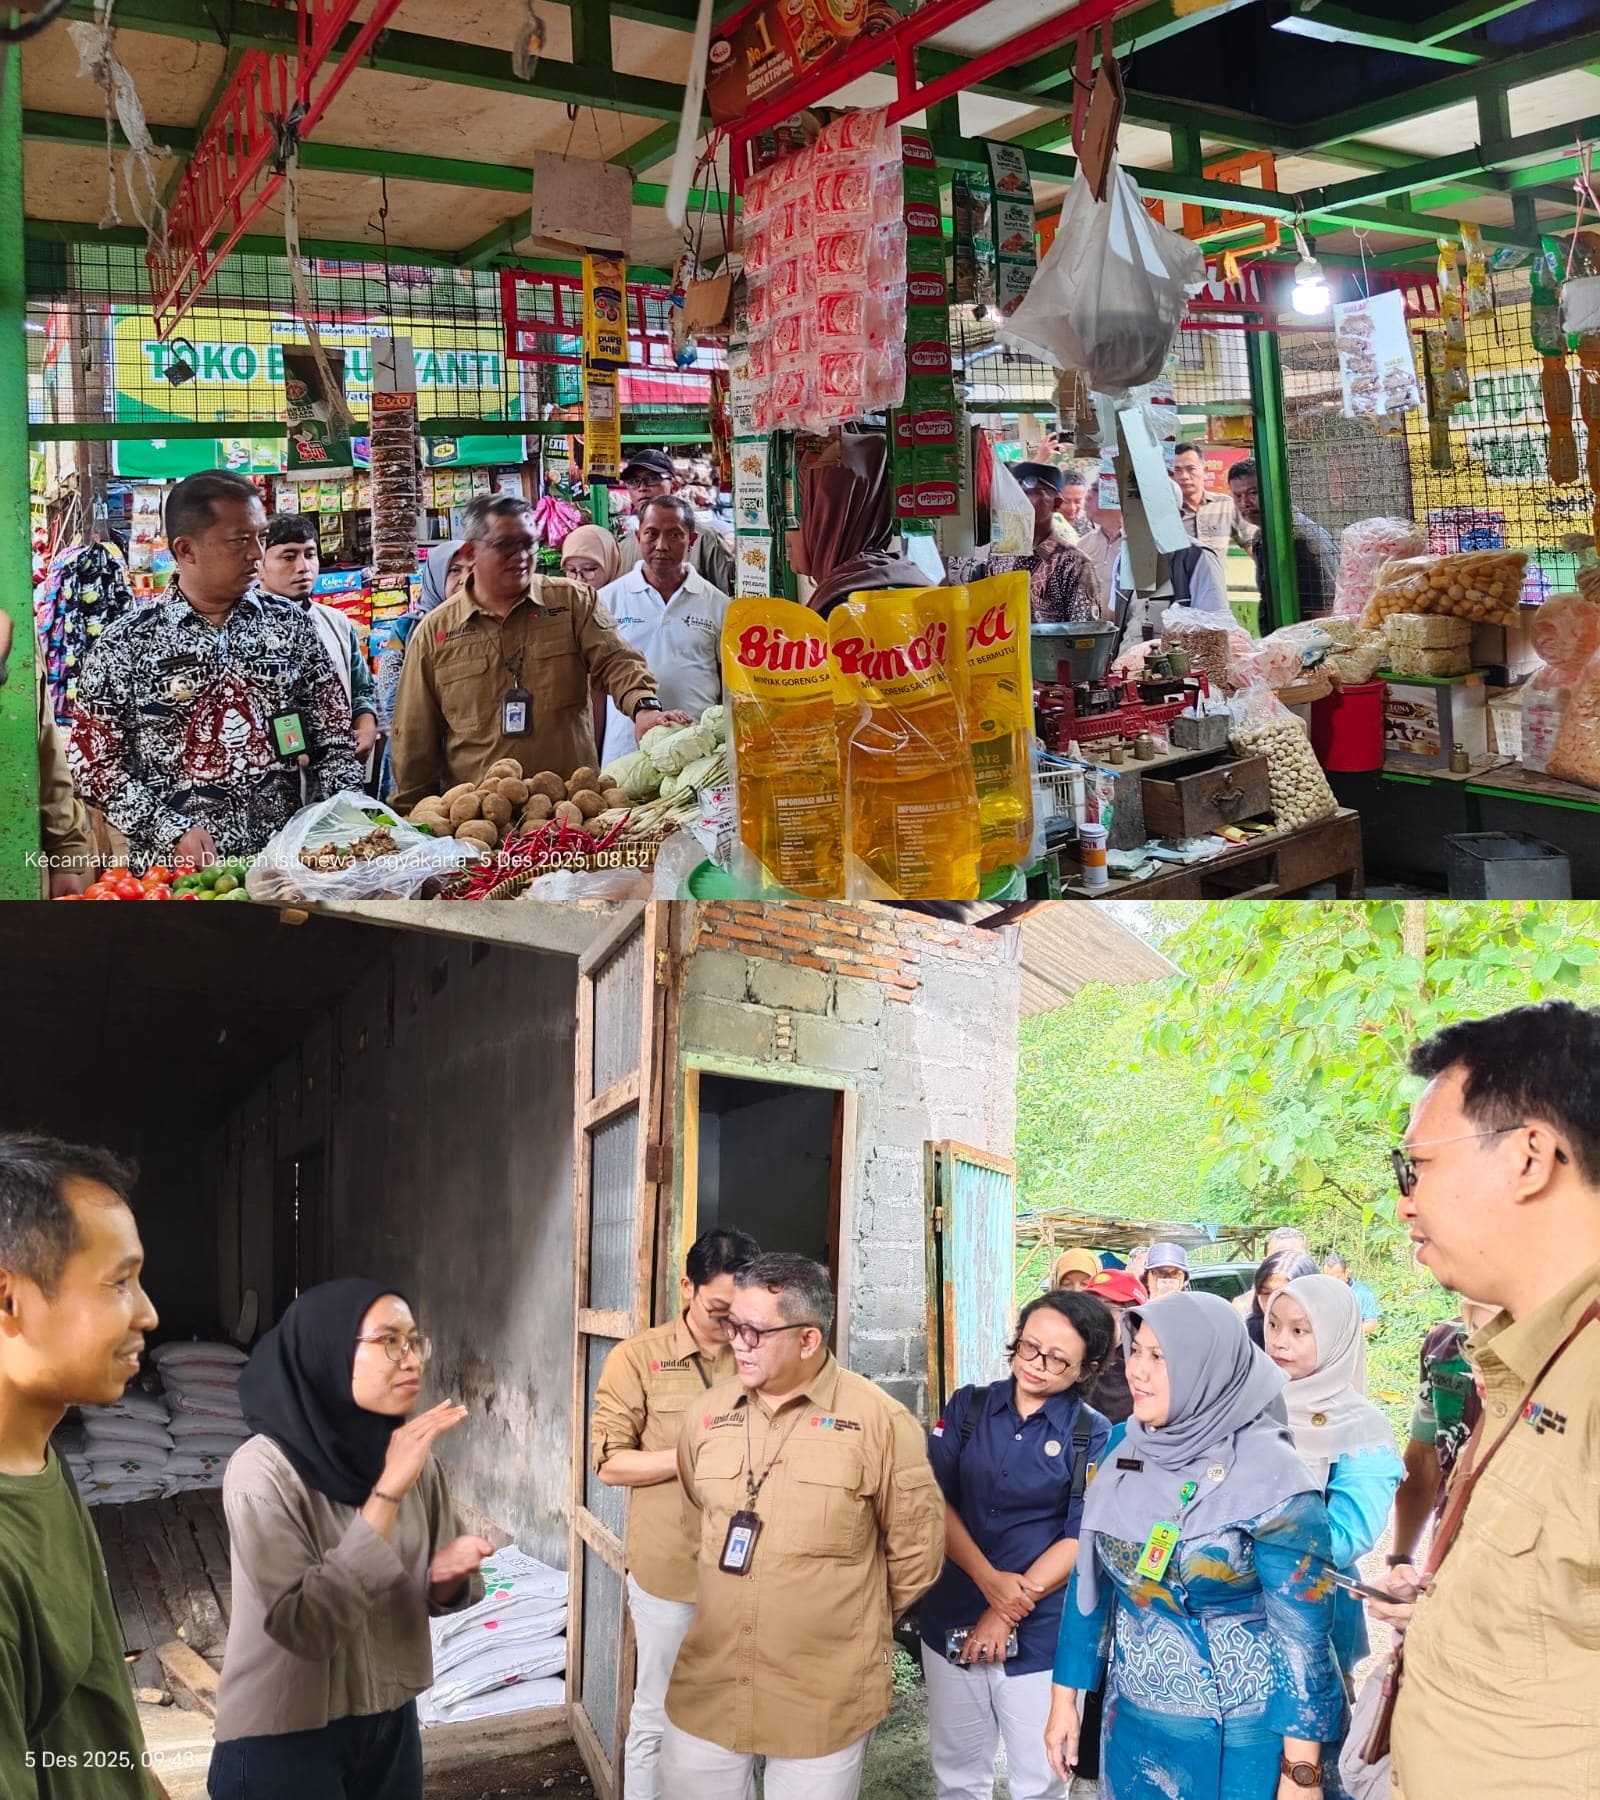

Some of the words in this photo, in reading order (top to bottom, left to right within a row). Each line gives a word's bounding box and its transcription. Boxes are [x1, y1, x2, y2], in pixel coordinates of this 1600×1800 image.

[597, 335, 622, 346] Band
[599, 344, 621, 356] Blue
[146, 344, 257, 380] TOKO
[913, 352, 947, 365] Ladaku
[376, 396, 408, 405] SOTO
[917, 422, 951, 436] Ladaku
[919, 493, 955, 506] Ladaku
[977, 646, 1016, 665] BERMUTU
[753, 674, 781, 686] MINYAK
[781, 675, 818, 687] GORENG
